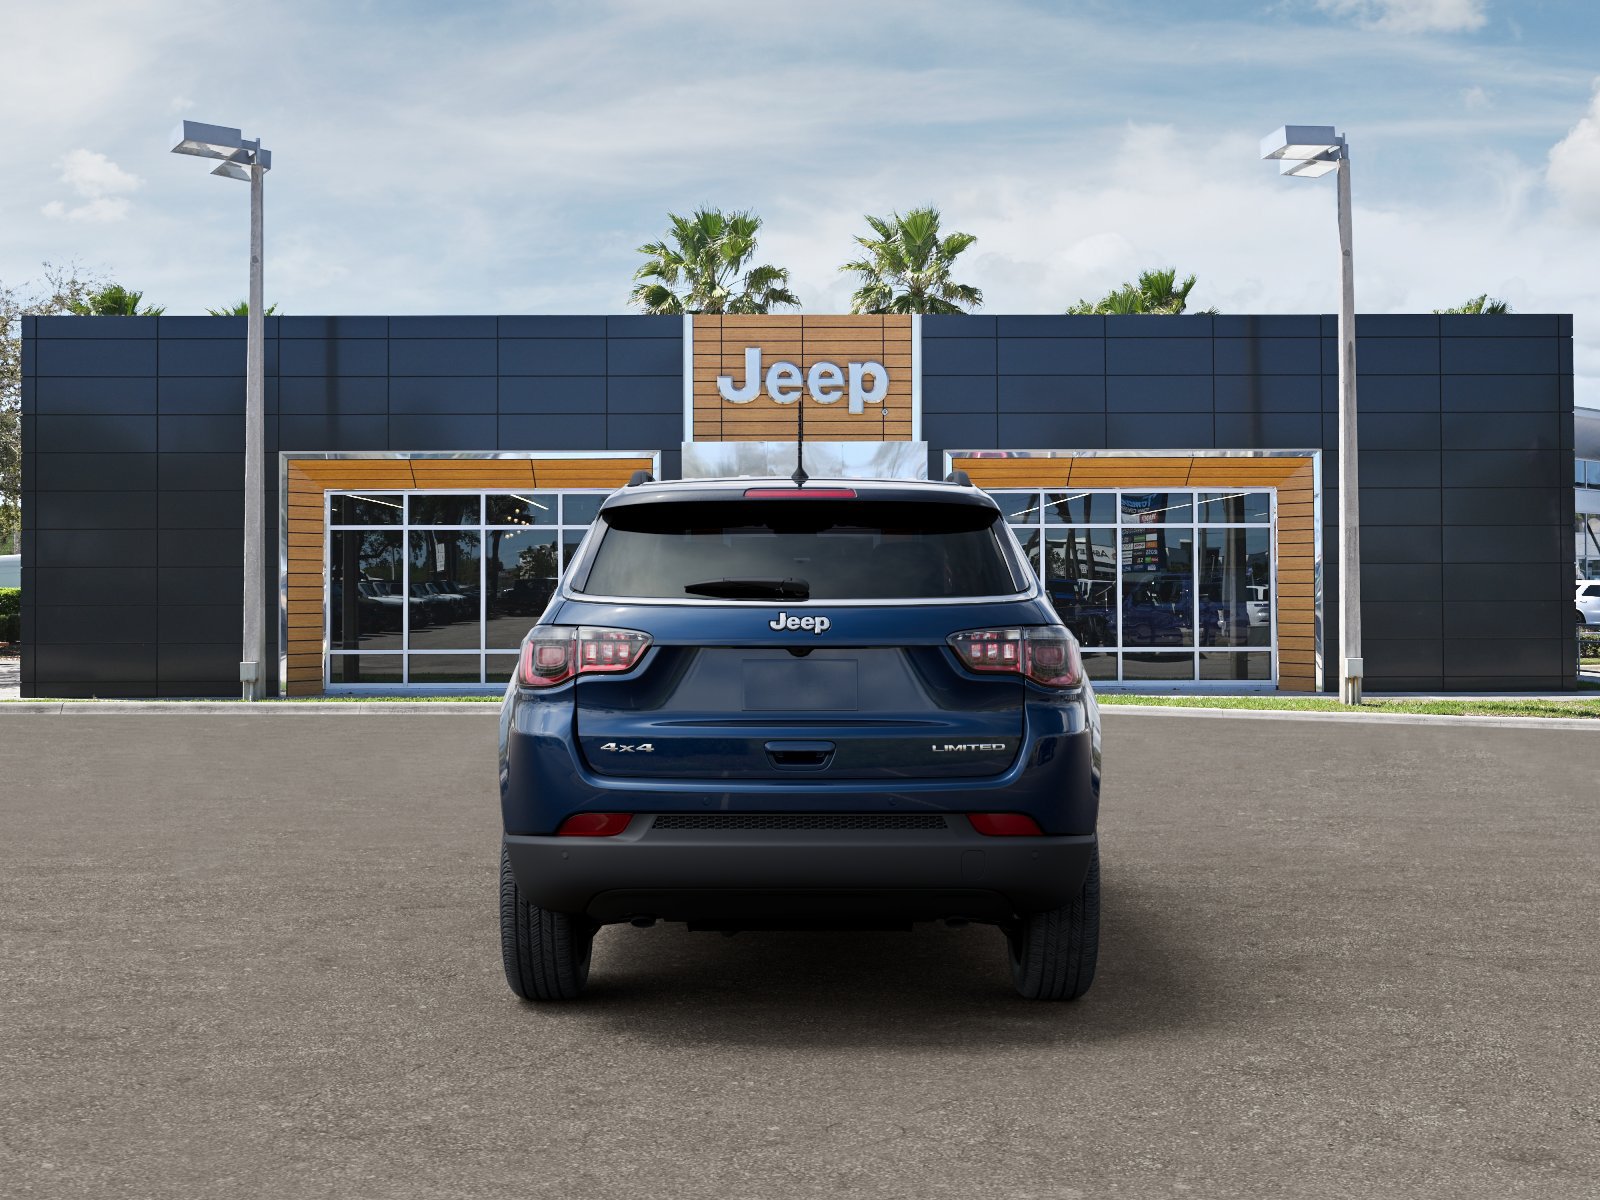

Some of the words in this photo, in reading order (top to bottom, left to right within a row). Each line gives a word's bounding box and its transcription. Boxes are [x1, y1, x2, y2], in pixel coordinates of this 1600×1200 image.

[716, 347, 890, 415] Jeep
[769, 611, 831, 635] Jeep
[600, 742, 655, 753] 4x4
[931, 743, 1006, 752] LIMITED
